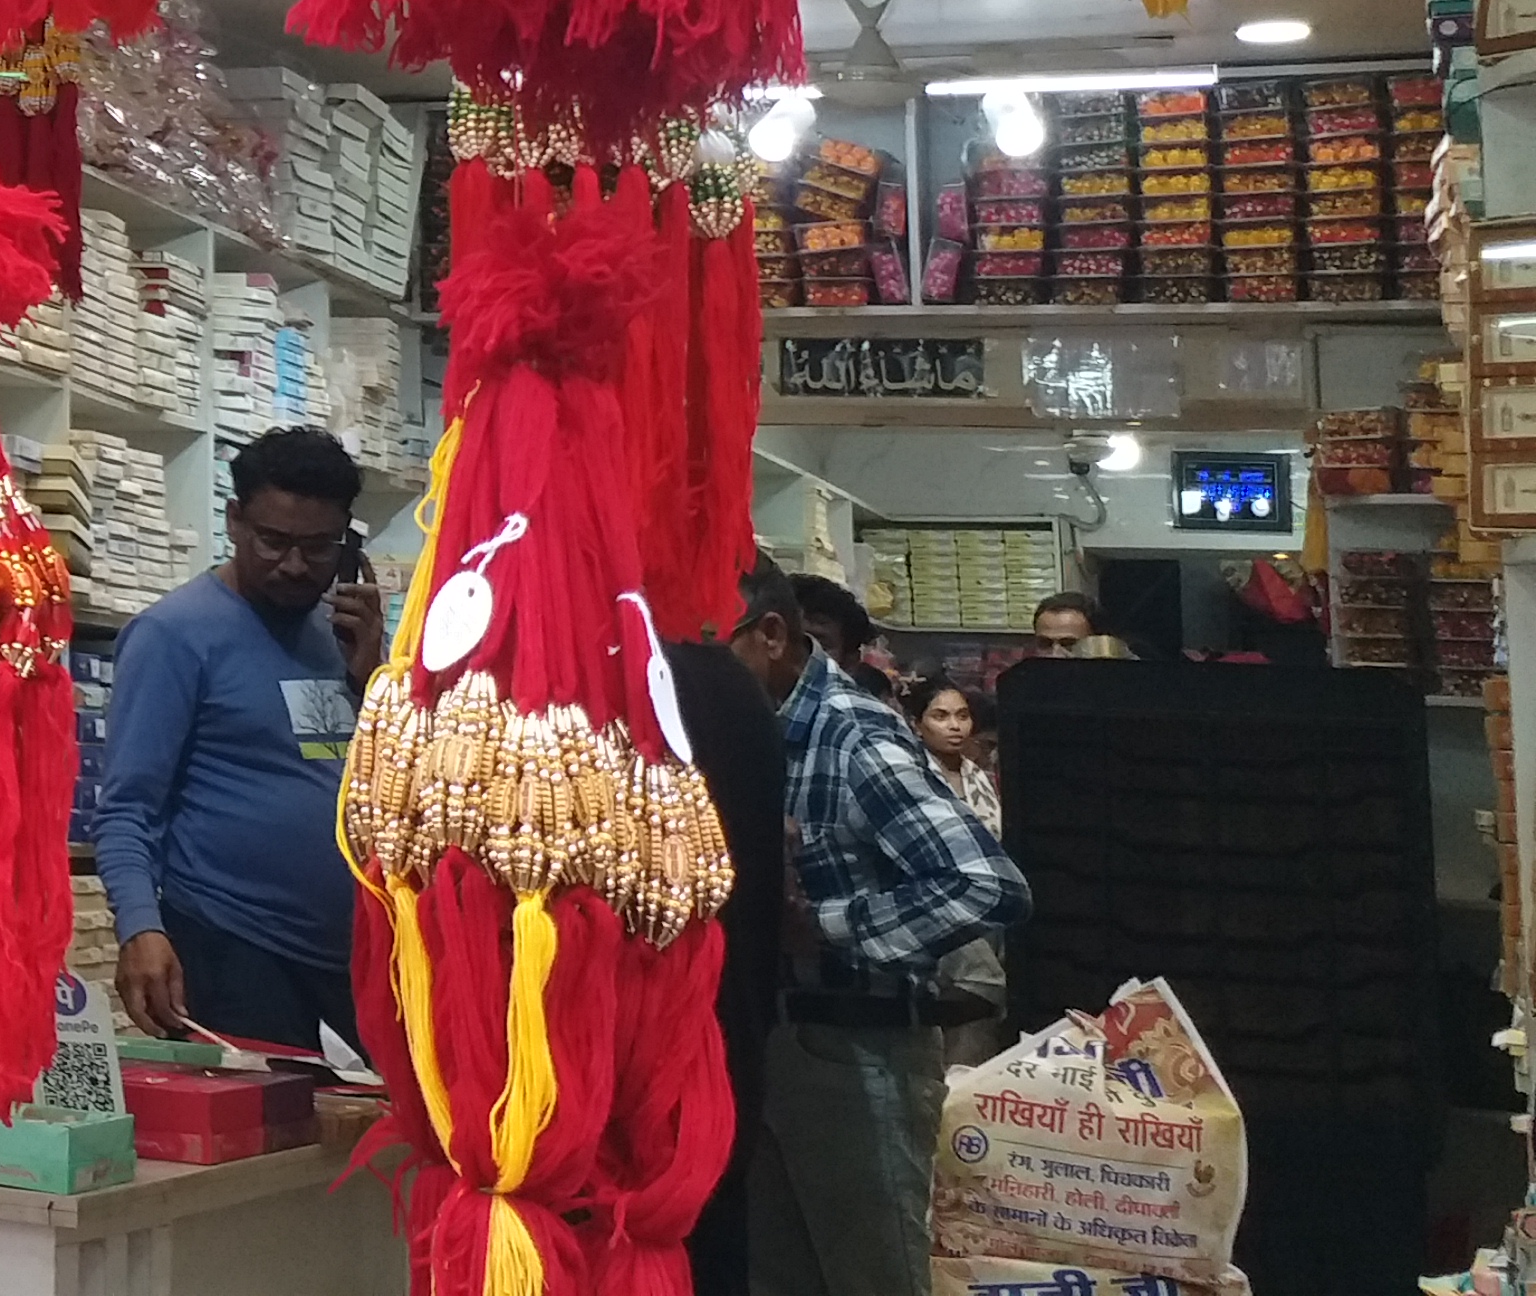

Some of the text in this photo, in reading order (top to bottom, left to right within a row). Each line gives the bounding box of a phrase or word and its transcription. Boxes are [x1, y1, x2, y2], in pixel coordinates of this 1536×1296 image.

[974, 1088, 1071, 1134] राखियाँ
[1076, 1101, 1106, 1141] ही
[1114, 1114, 1205, 1153] राखियाँ
[1053, 1211, 1072, 1232] के
